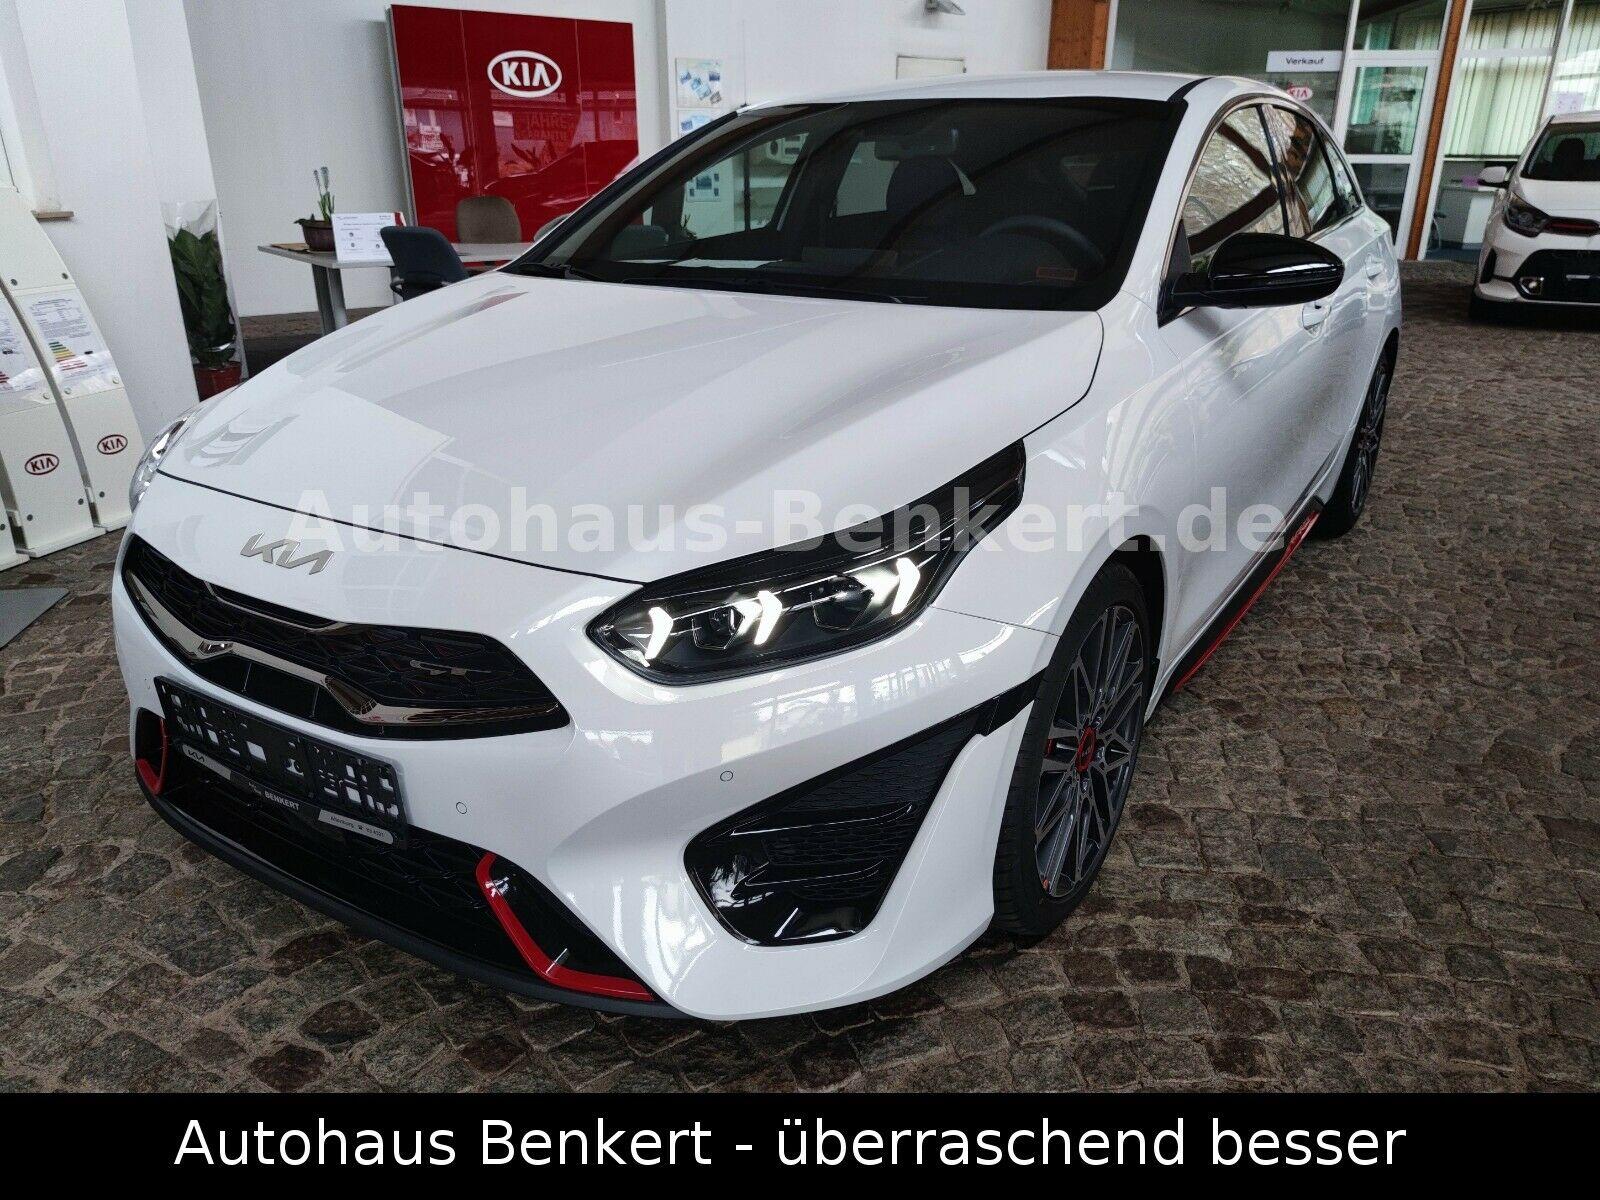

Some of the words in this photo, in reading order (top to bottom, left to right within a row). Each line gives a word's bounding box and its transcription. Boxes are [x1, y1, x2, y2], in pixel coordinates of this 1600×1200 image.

[501, 61, 551, 87] KIA
[240, 532, 334, 575] KIA
[264, 790, 299, 810] BENKERT
